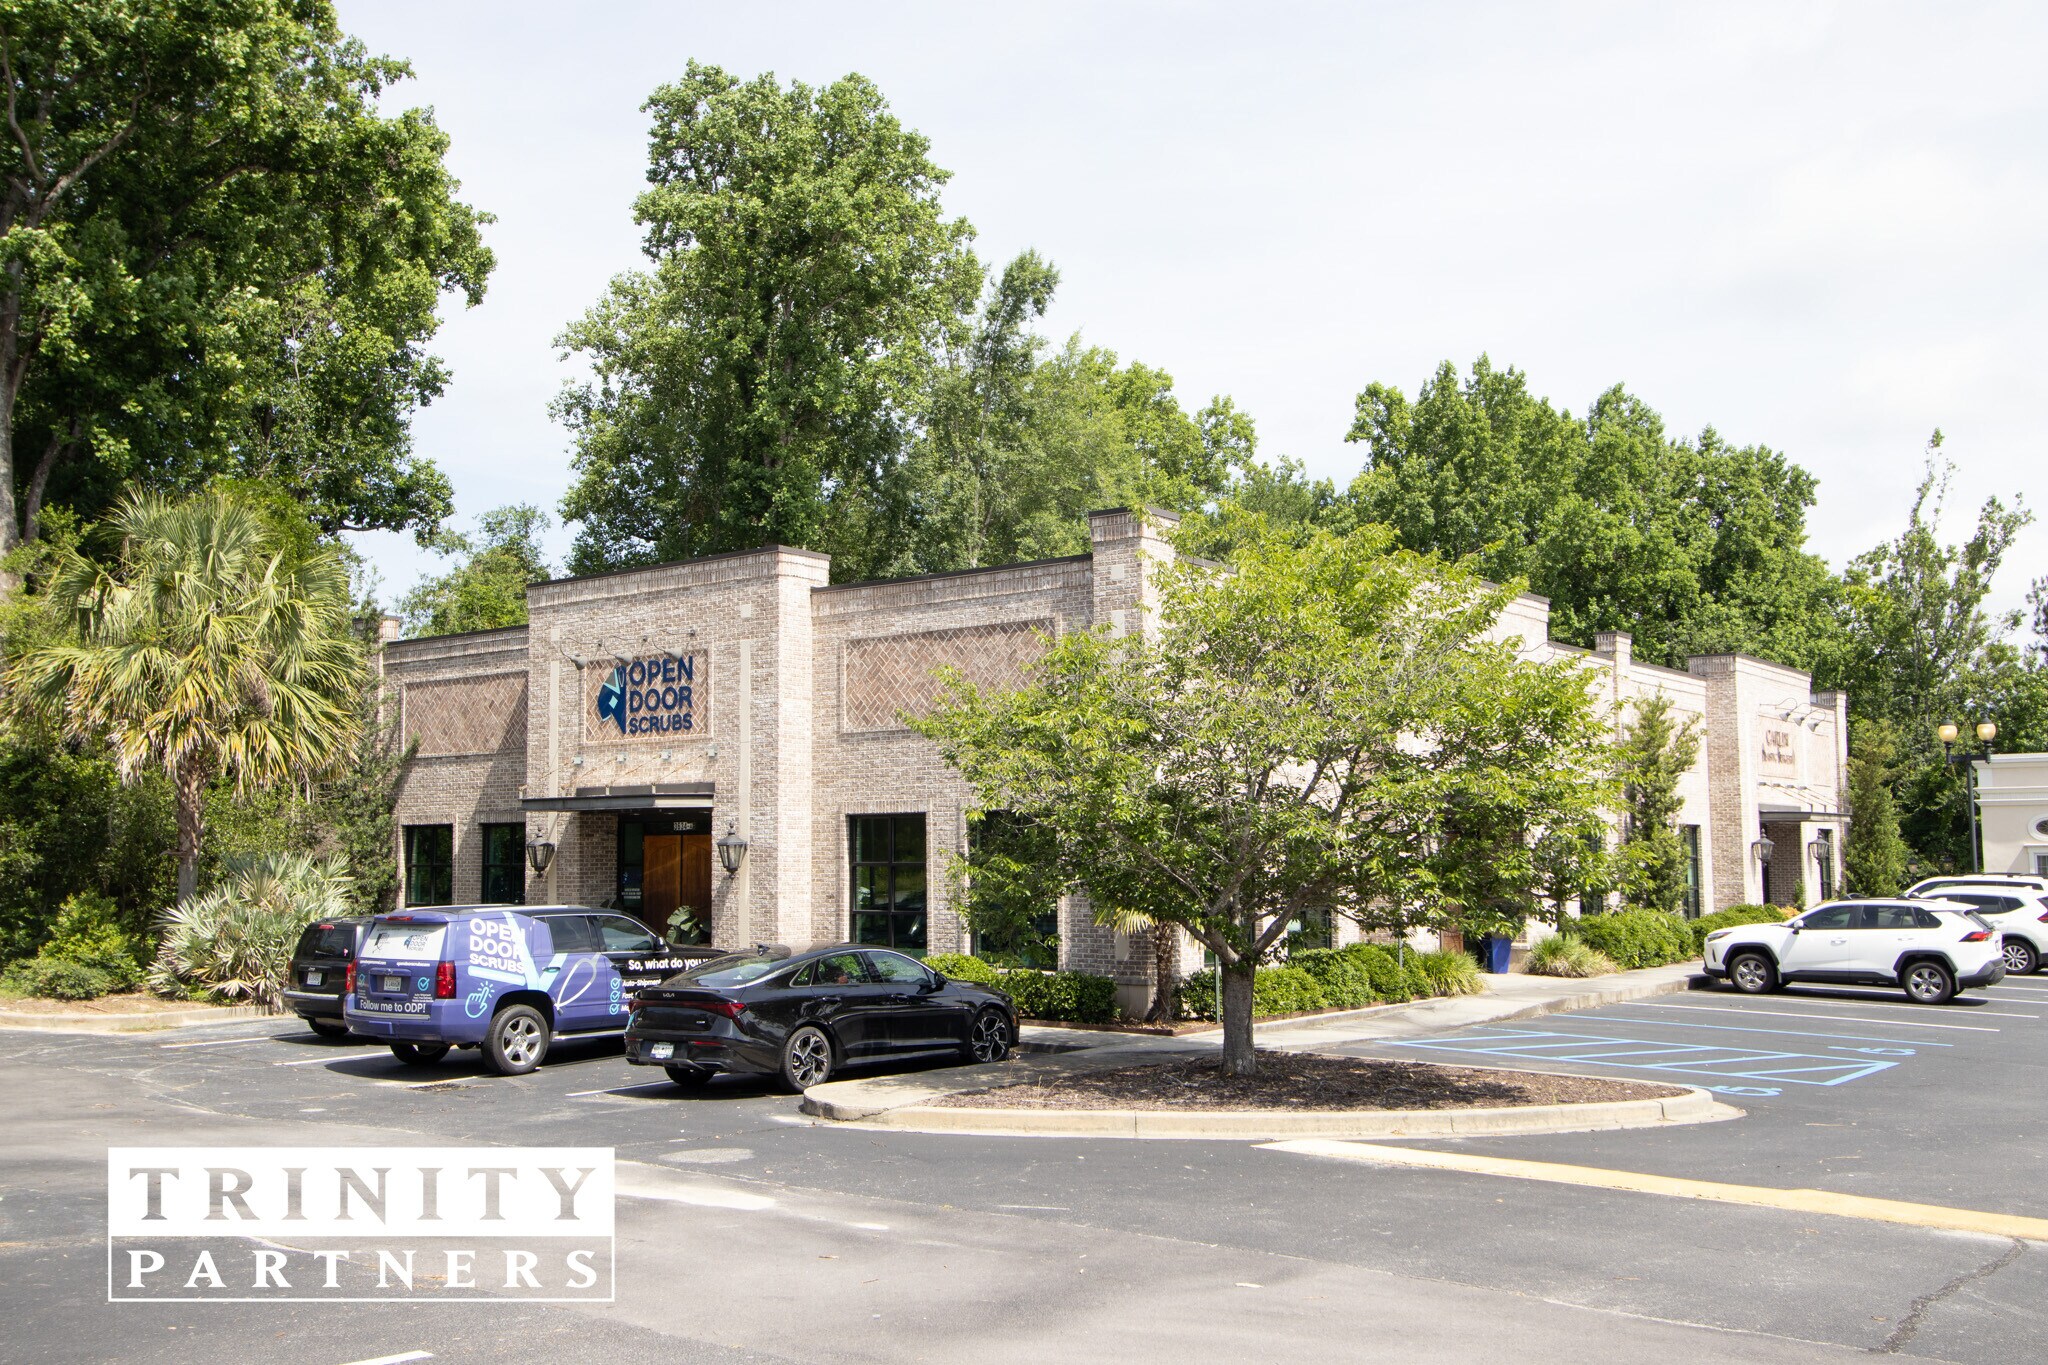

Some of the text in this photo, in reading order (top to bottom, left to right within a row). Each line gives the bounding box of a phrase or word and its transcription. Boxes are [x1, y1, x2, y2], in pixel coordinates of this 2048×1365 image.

[629, 655, 693, 686] OPEN
[629, 686, 693, 713] DOOR
[629, 713, 693, 734] SCRUBS
[469, 953, 525, 974] SCRUBS
[628, 959, 643, 971] So,
[645, 958, 669, 970] what
[670, 957, 683, 968] do
[360, 999, 426, 1013] Follow me to ODP!
